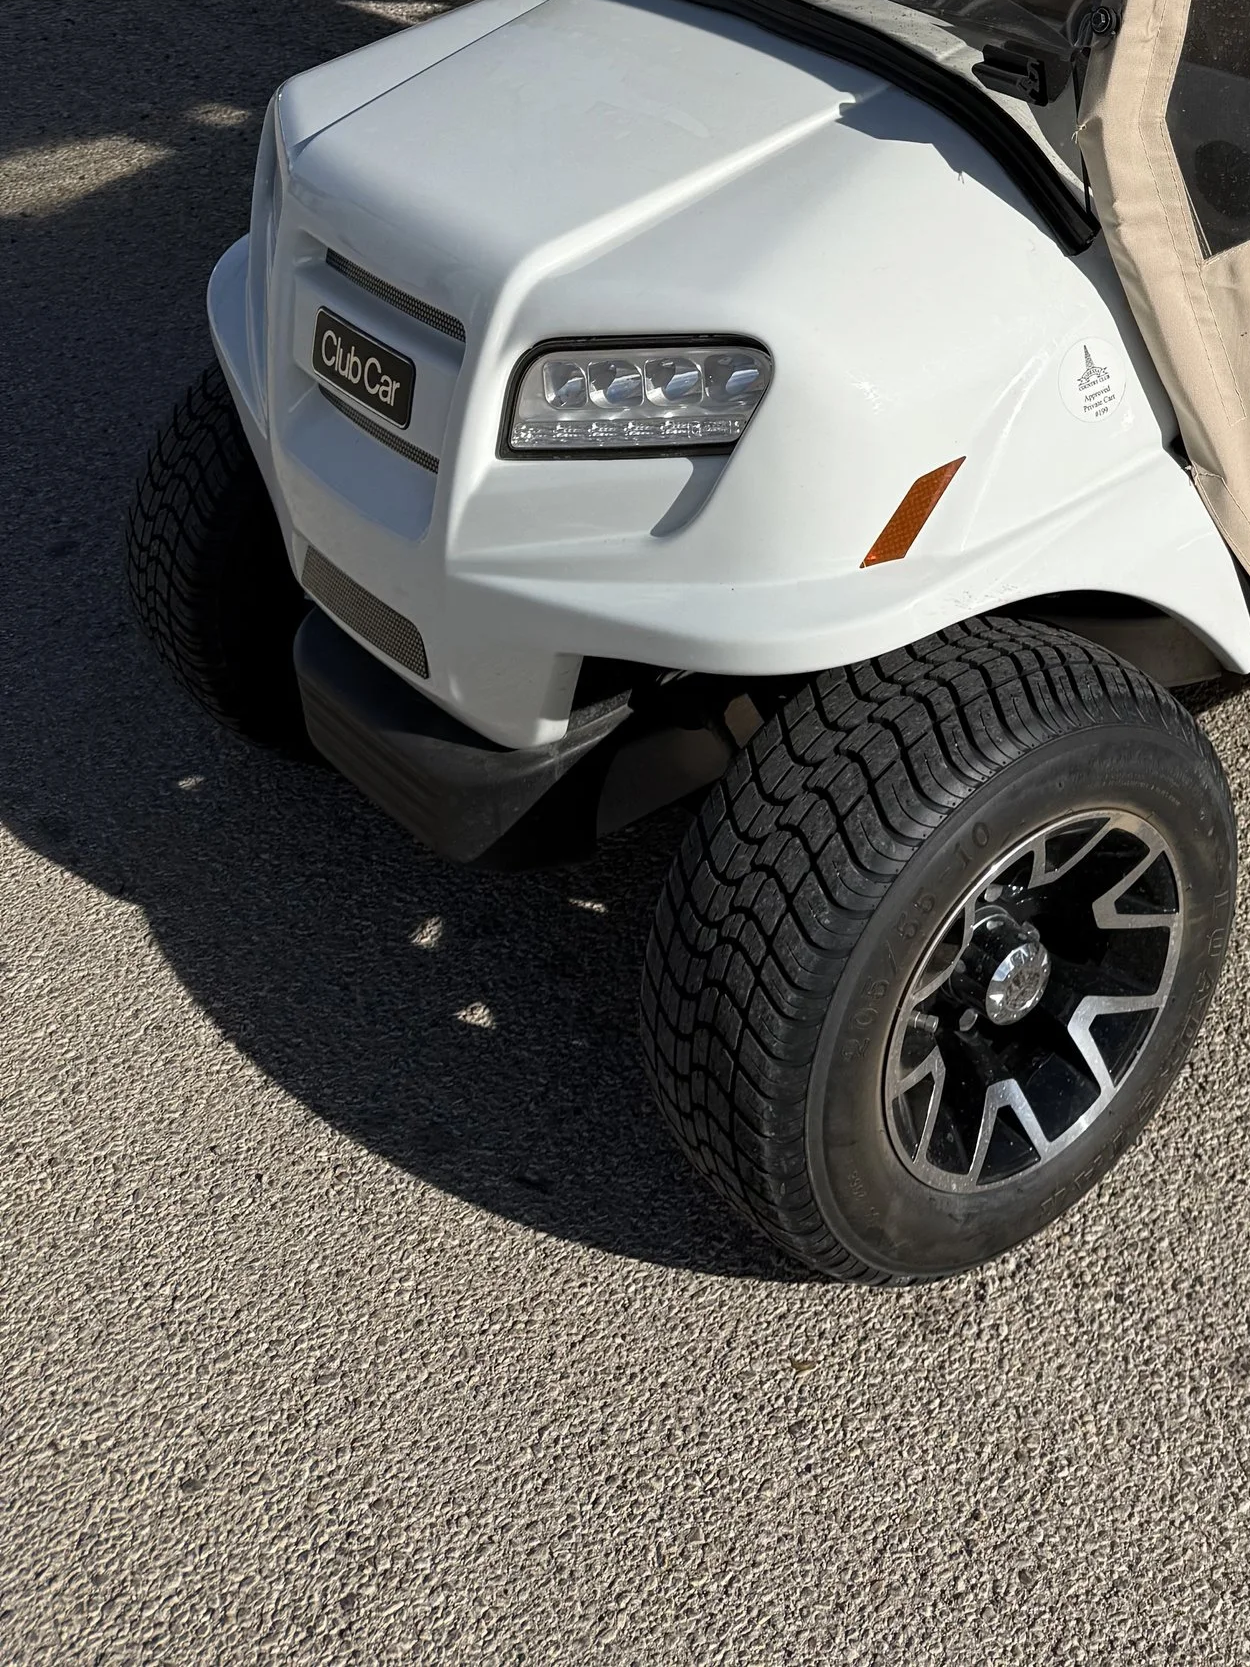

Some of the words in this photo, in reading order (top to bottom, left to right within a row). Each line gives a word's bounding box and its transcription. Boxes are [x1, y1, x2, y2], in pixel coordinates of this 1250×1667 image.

[321, 329, 362, 384] Club
[363, 357, 401, 407] Car
[1085, 385, 1110, 402] Approved
[1083, 401, 1102, 412] Private
